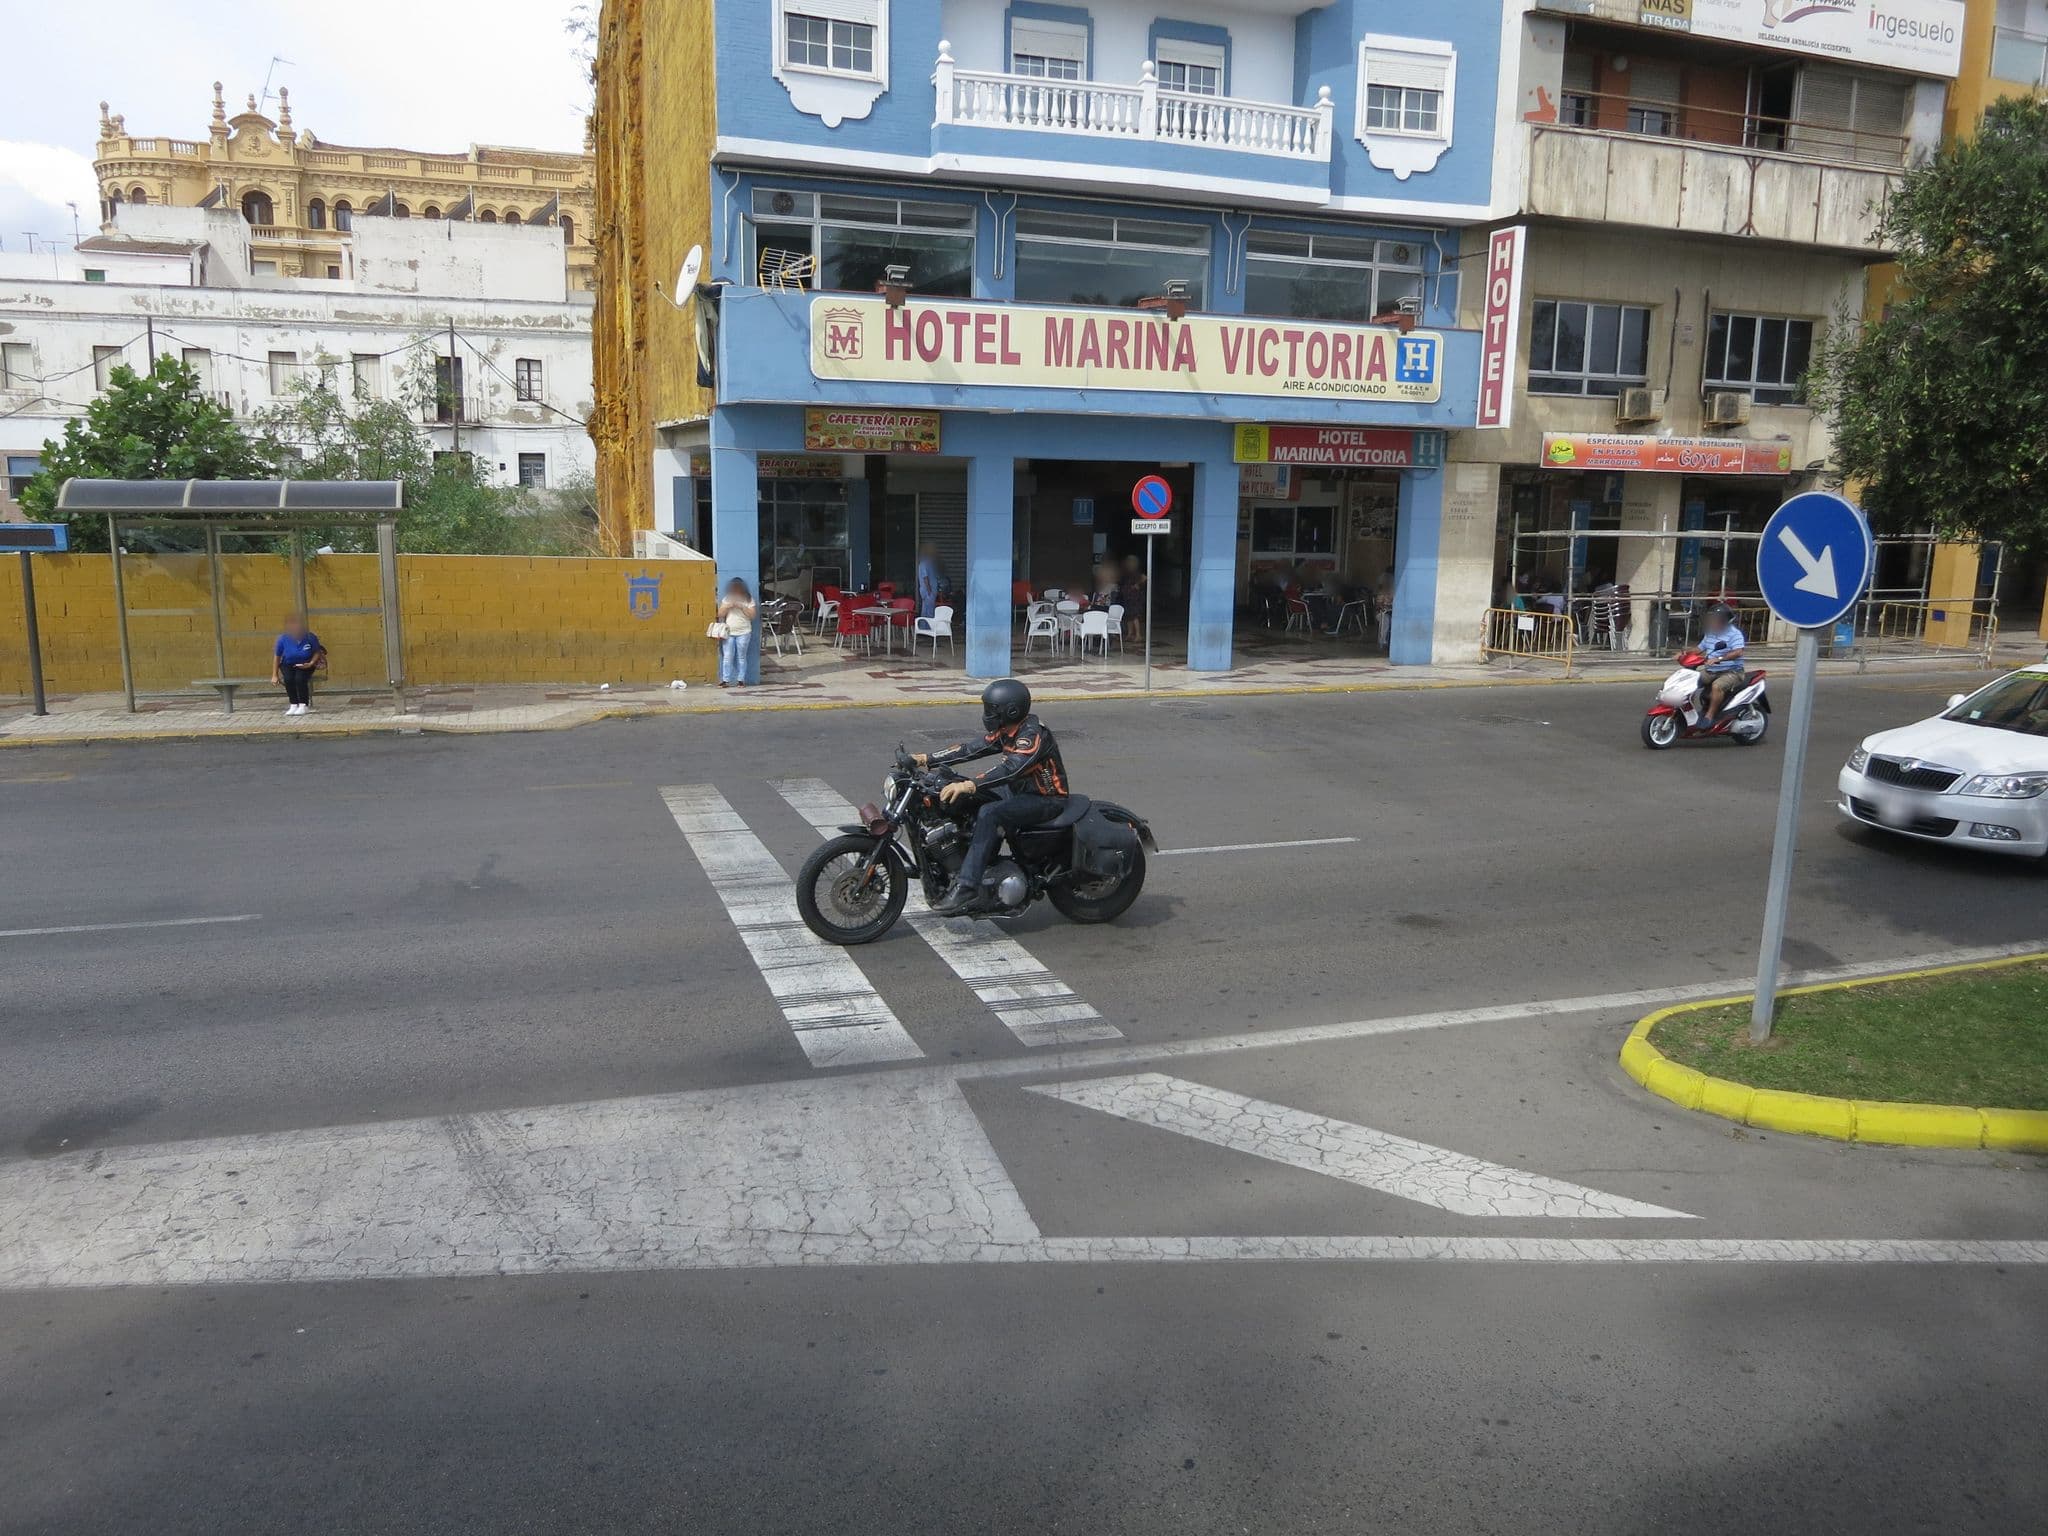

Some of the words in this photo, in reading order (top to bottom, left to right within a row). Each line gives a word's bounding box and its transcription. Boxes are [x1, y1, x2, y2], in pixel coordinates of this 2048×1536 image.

[1869, 5, 1954, 43] ingesuelo
[1484, 239, 1511, 418] HOTEL
[885, 309, 1021, 366] HOTEL
[1044, 316, 1197, 373] MARINA
[1220, 326, 1388, 382] VICTORIA
[1282, 380, 1305, 391] AIRE
[1307, 382, 1387, 394] ACONDICIONADO
[827, 412, 896, 426] CAFETERÍA
[899, 416, 921, 428] RIF
[1318, 430, 1367, 446] HOTEL
[1587, 438, 1645, 446] ESPECIALIDAD
[1699, 440, 1743, 448] RESTAURANTE
[1274, 446, 1336, 462] MARINA
[1339, 448, 1407, 464] VICTORIA
[1678, 449, 1720, 471] Goya
